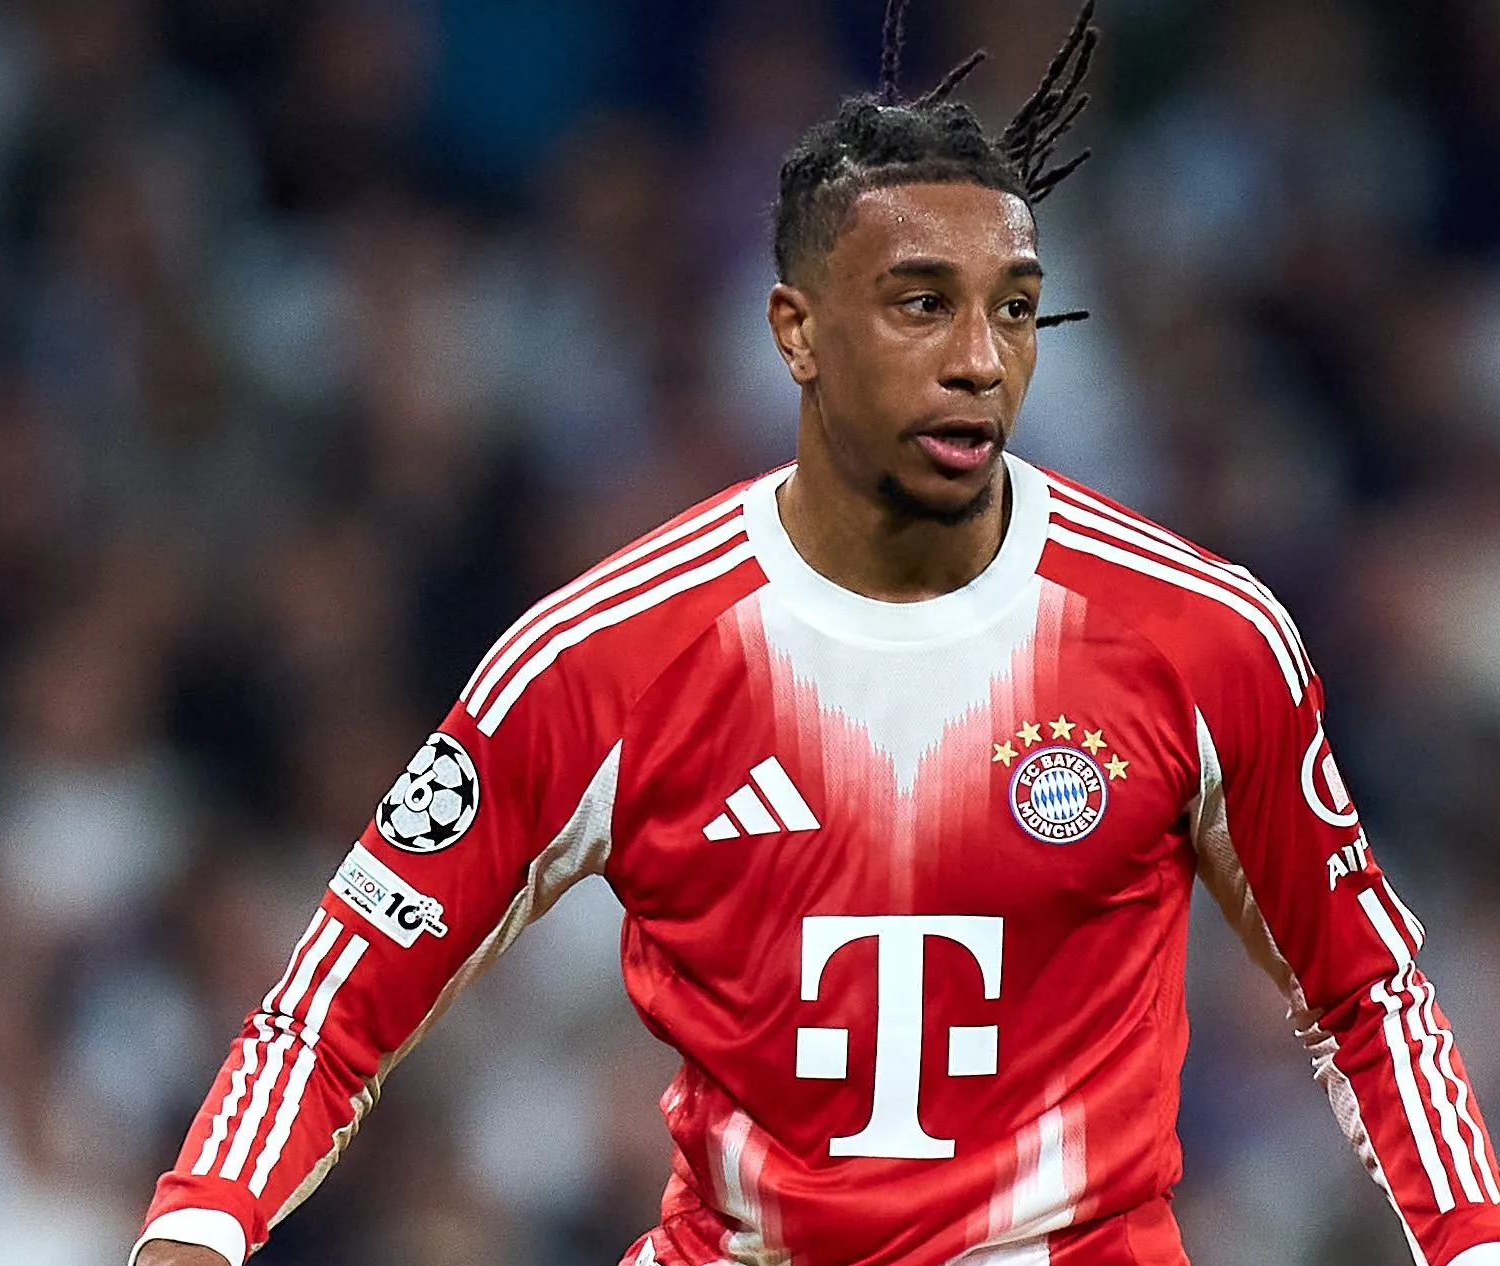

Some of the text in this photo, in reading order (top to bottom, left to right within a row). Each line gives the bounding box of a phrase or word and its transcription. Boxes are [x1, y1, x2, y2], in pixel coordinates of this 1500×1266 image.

[1020, 753, 1100, 793] FC BAYERN
[796, 914, 1004, 1159] T
